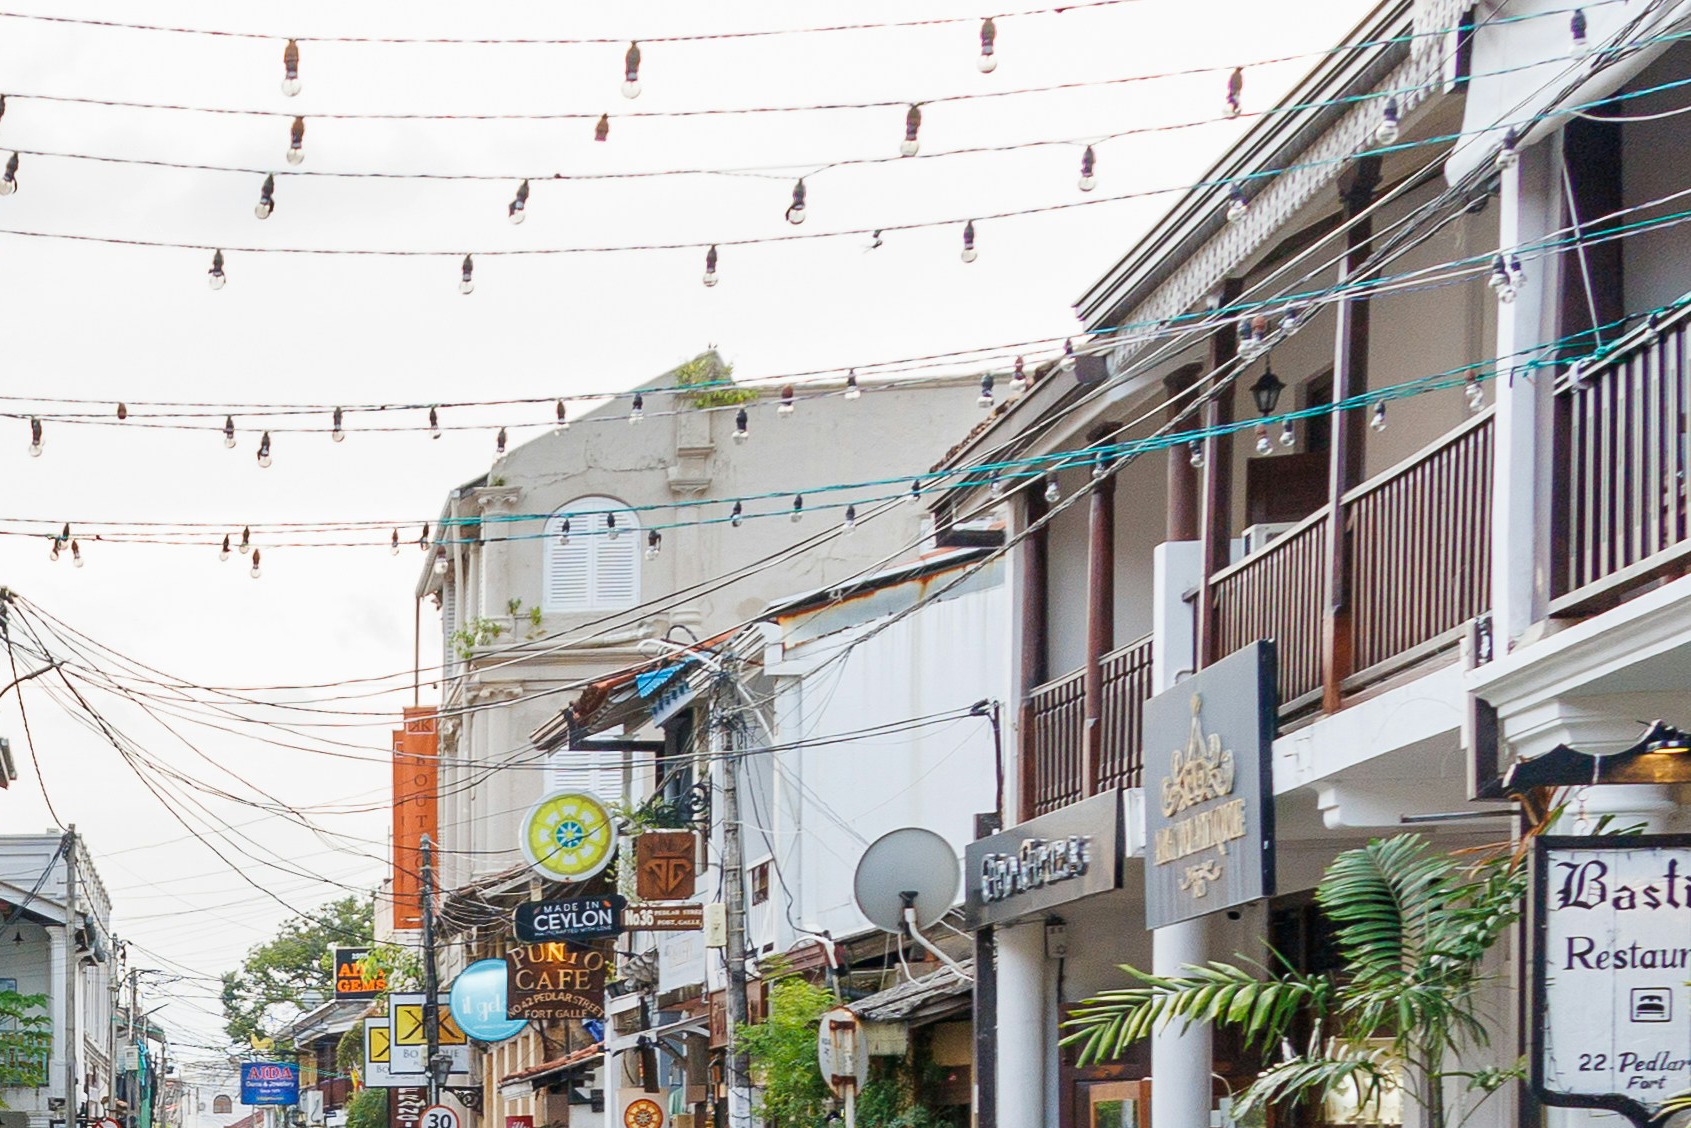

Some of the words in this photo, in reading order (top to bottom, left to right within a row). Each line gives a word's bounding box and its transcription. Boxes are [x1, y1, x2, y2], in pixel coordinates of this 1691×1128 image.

[543, 901, 579, 914] MADE
[586, 901, 600, 910] IN
[533, 909, 613, 931] CEYLON
[625, 909, 654, 926] No36
[337, 979, 387, 992] GEMS
[515, 968, 592, 990] CAFE
[476, 994, 505, 1022] gel
[508, 1004, 522, 1018] NO
[534, 992, 572, 1005] PEDLAR
[573, 996, 605, 1017] STREET
[524, 1009, 553, 1019] FORT
[555, 1009, 587, 1018] GALLE
[247, 1066, 294, 1079] AIDA
[1627, 1075, 1667, 1090] Fort
